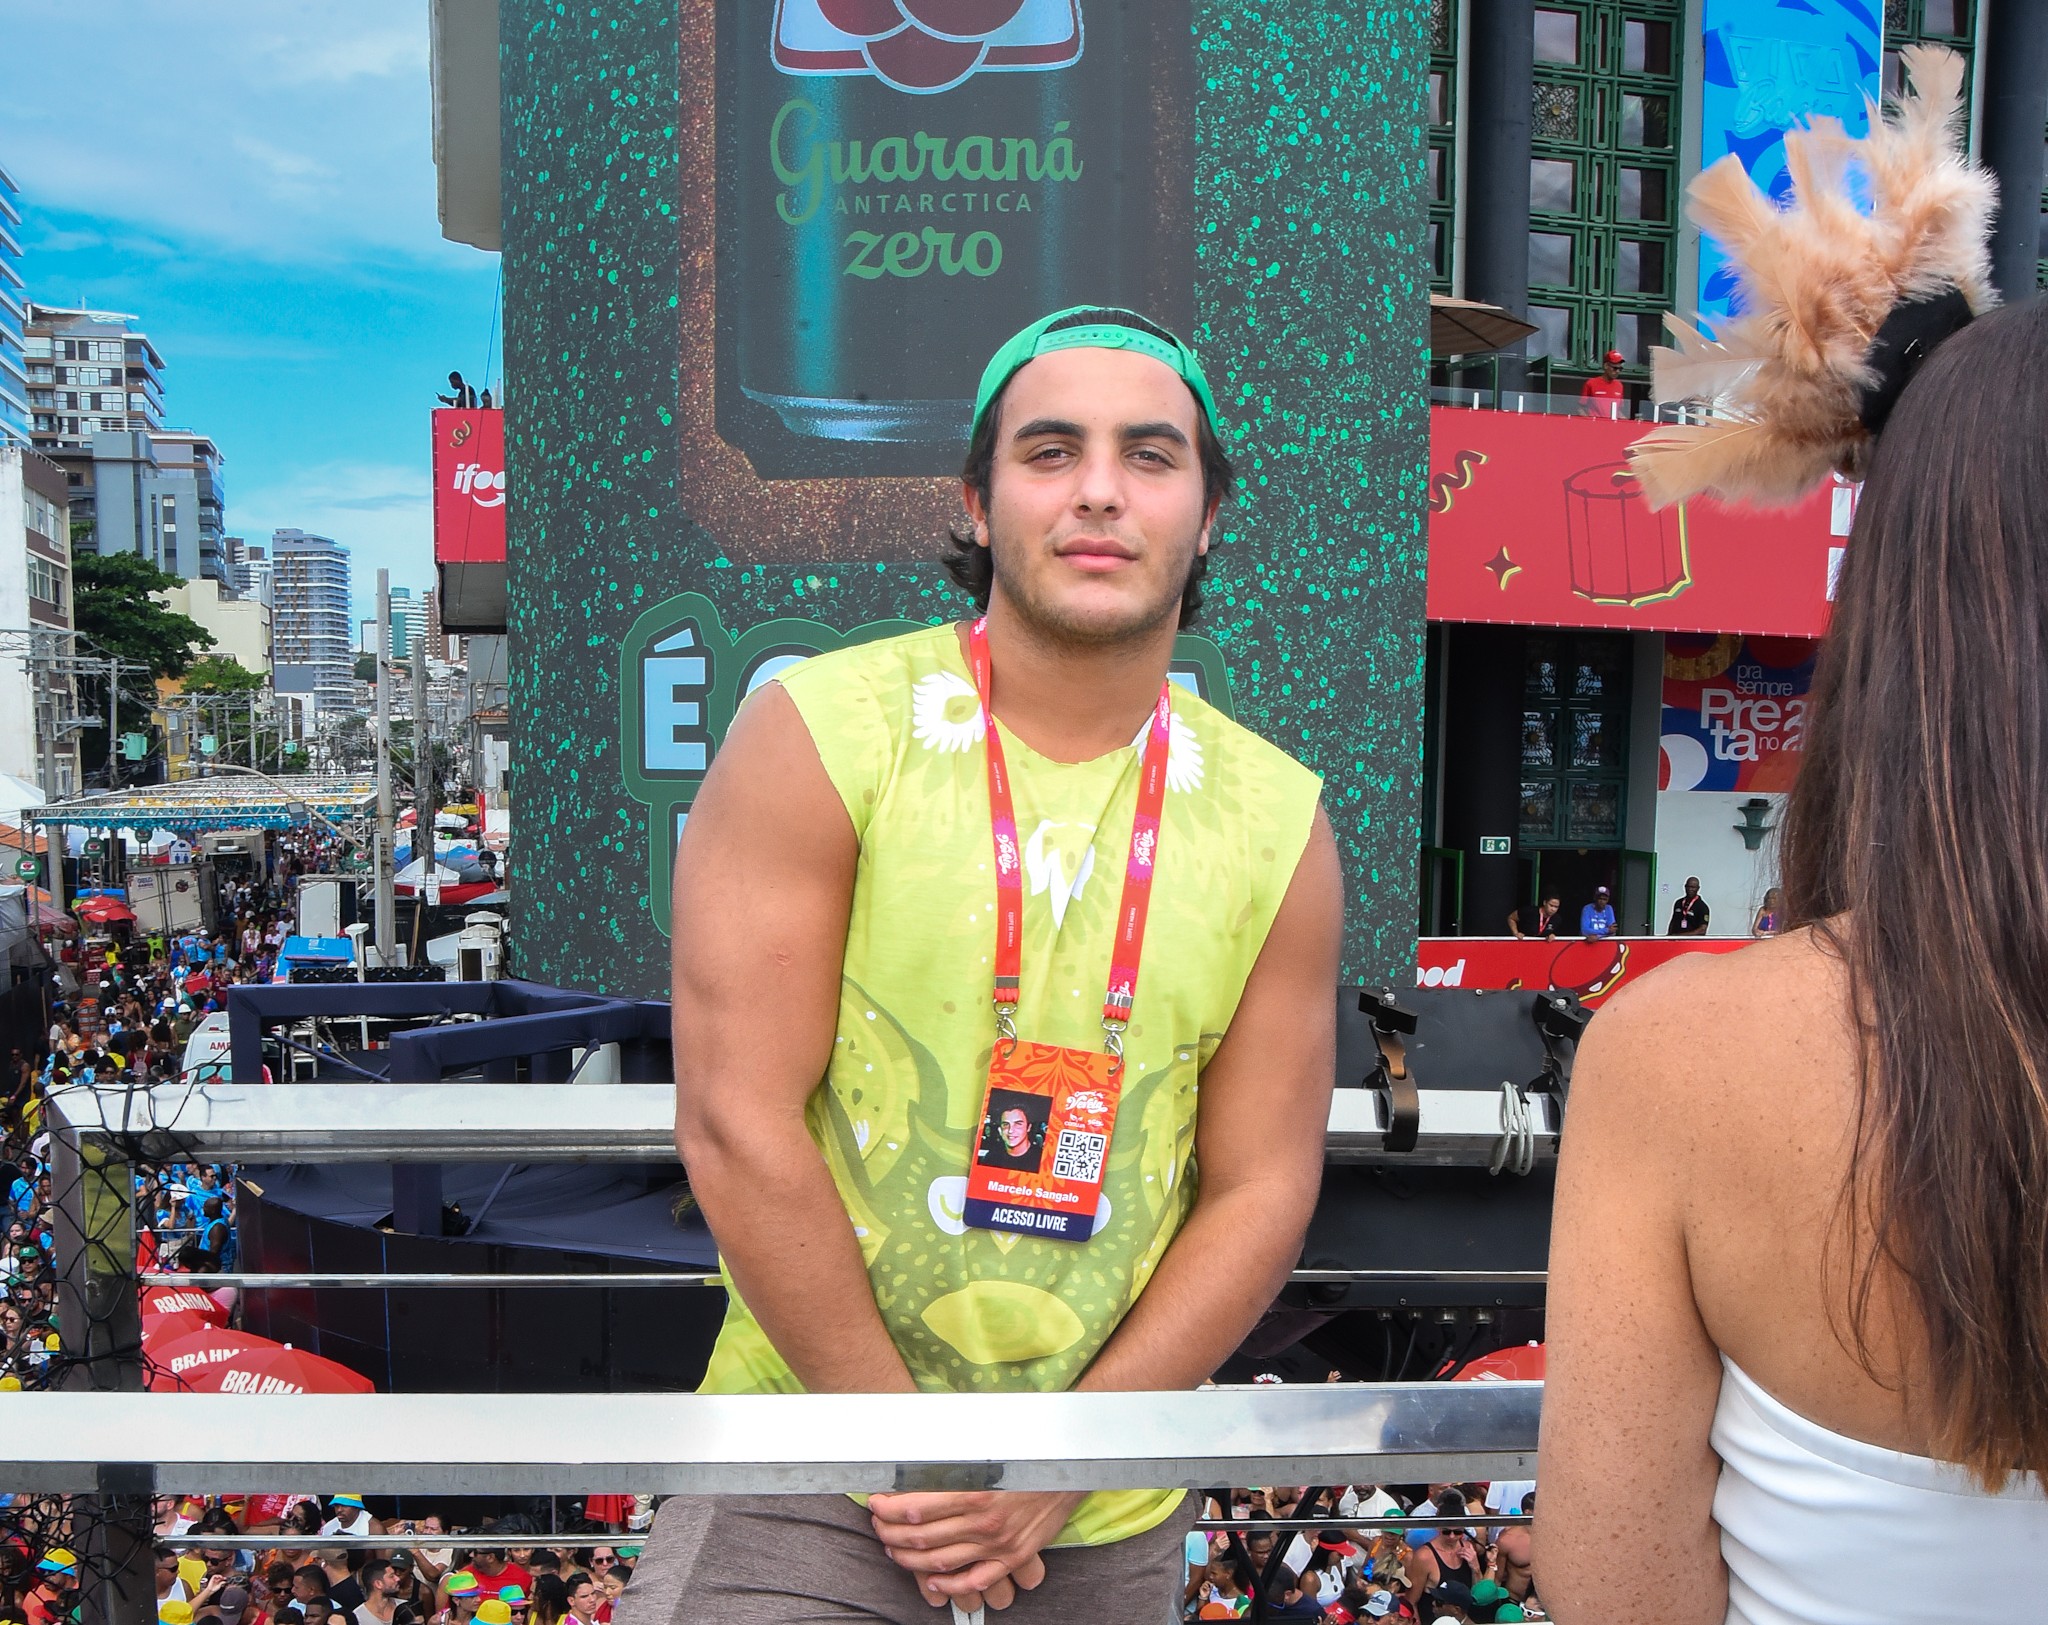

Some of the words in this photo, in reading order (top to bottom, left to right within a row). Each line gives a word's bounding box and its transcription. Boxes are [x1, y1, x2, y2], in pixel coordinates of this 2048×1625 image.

[770, 99, 1083, 226] Guaraná
[836, 193, 1032, 214] ANTARCTICA
[843, 226, 1002, 279] zero
[453, 463, 505, 494] ifoo
[1737, 664, 1762, 681] pra
[644, 628, 706, 770] É
[1736, 680, 1793, 699] sempre
[1701, 688, 1781, 732] Pre
[1783, 699, 1808, 732] 2
[1759, 736, 1779, 751] no
[988, 1181, 1032, 1196] Marcelo
[1035, 1187, 1079, 1203] Sangalo
[991, 1208, 1035, 1227] ACESSO
[1035, 1213, 1068, 1232] LIVRE
[153, 1293, 216, 1314] BRAHMA
[171, 1349, 247, 1374] BRAHM
